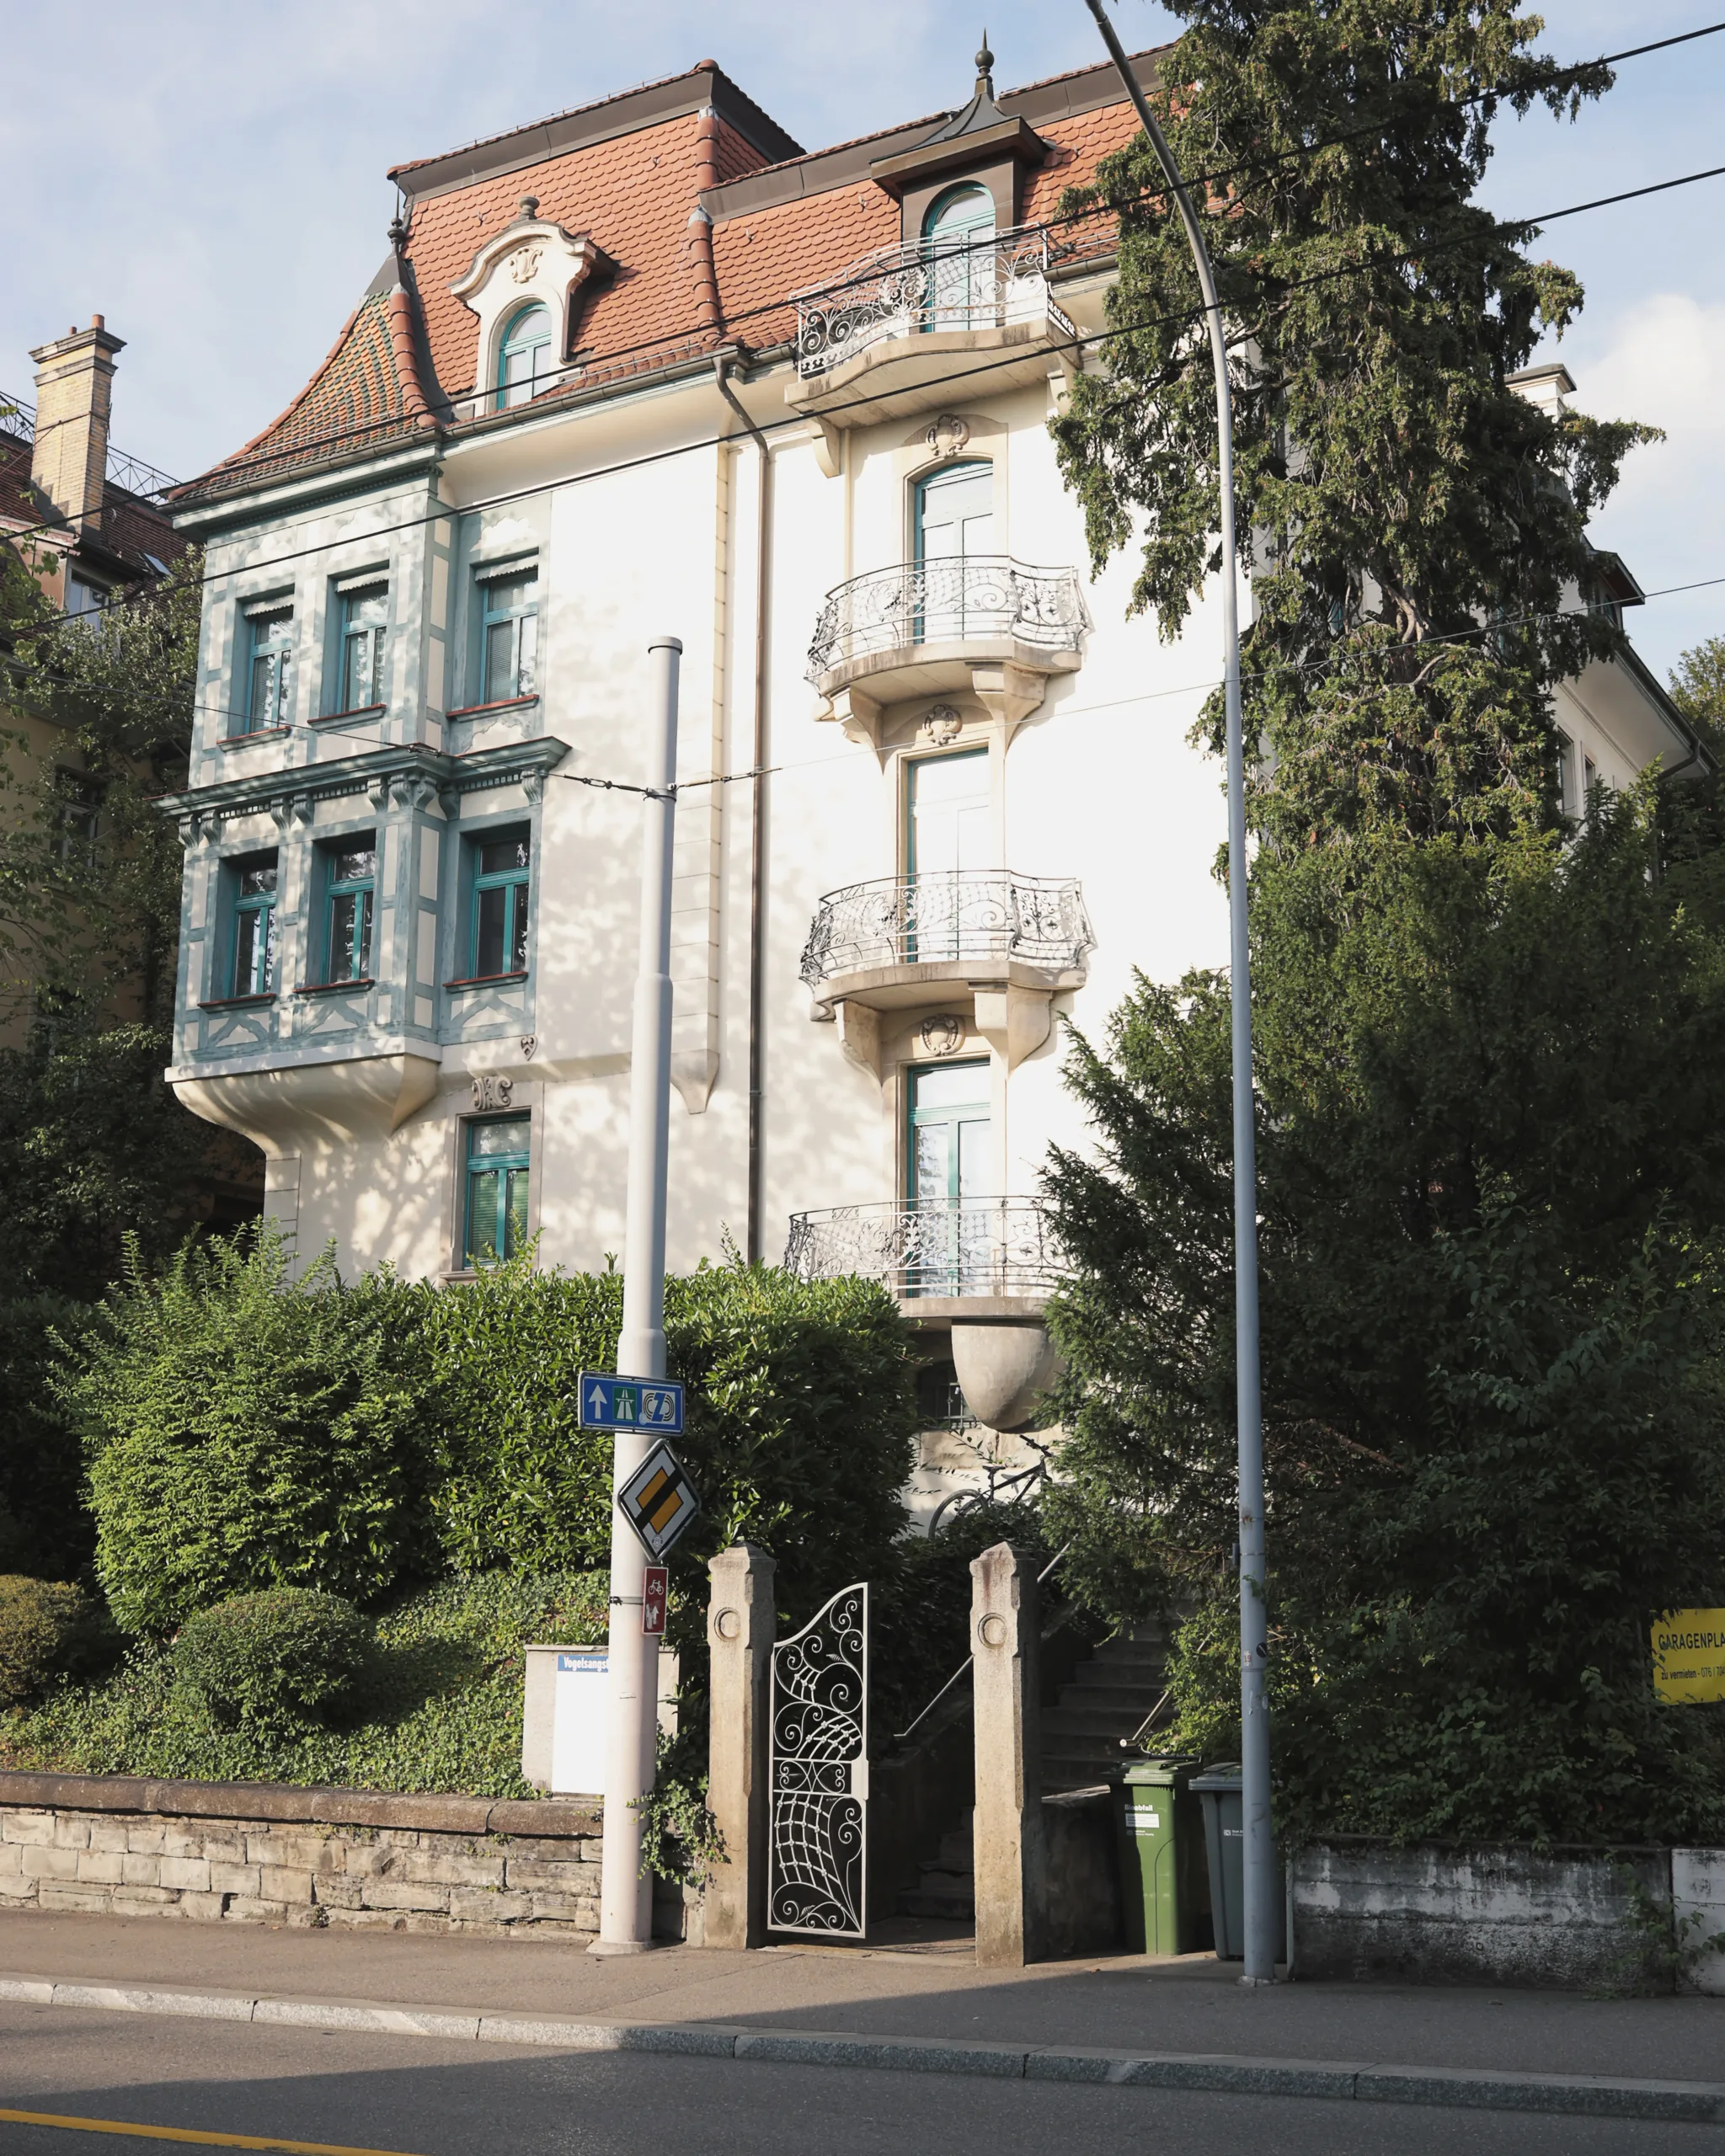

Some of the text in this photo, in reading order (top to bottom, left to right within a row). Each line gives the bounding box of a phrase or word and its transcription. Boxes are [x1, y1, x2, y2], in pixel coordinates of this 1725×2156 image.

[1661, 1672, 1668, 1680] zu
[1670, 1668, 1696, 1679] vermieten
[1701, 1667, 1712, 1678] 076
